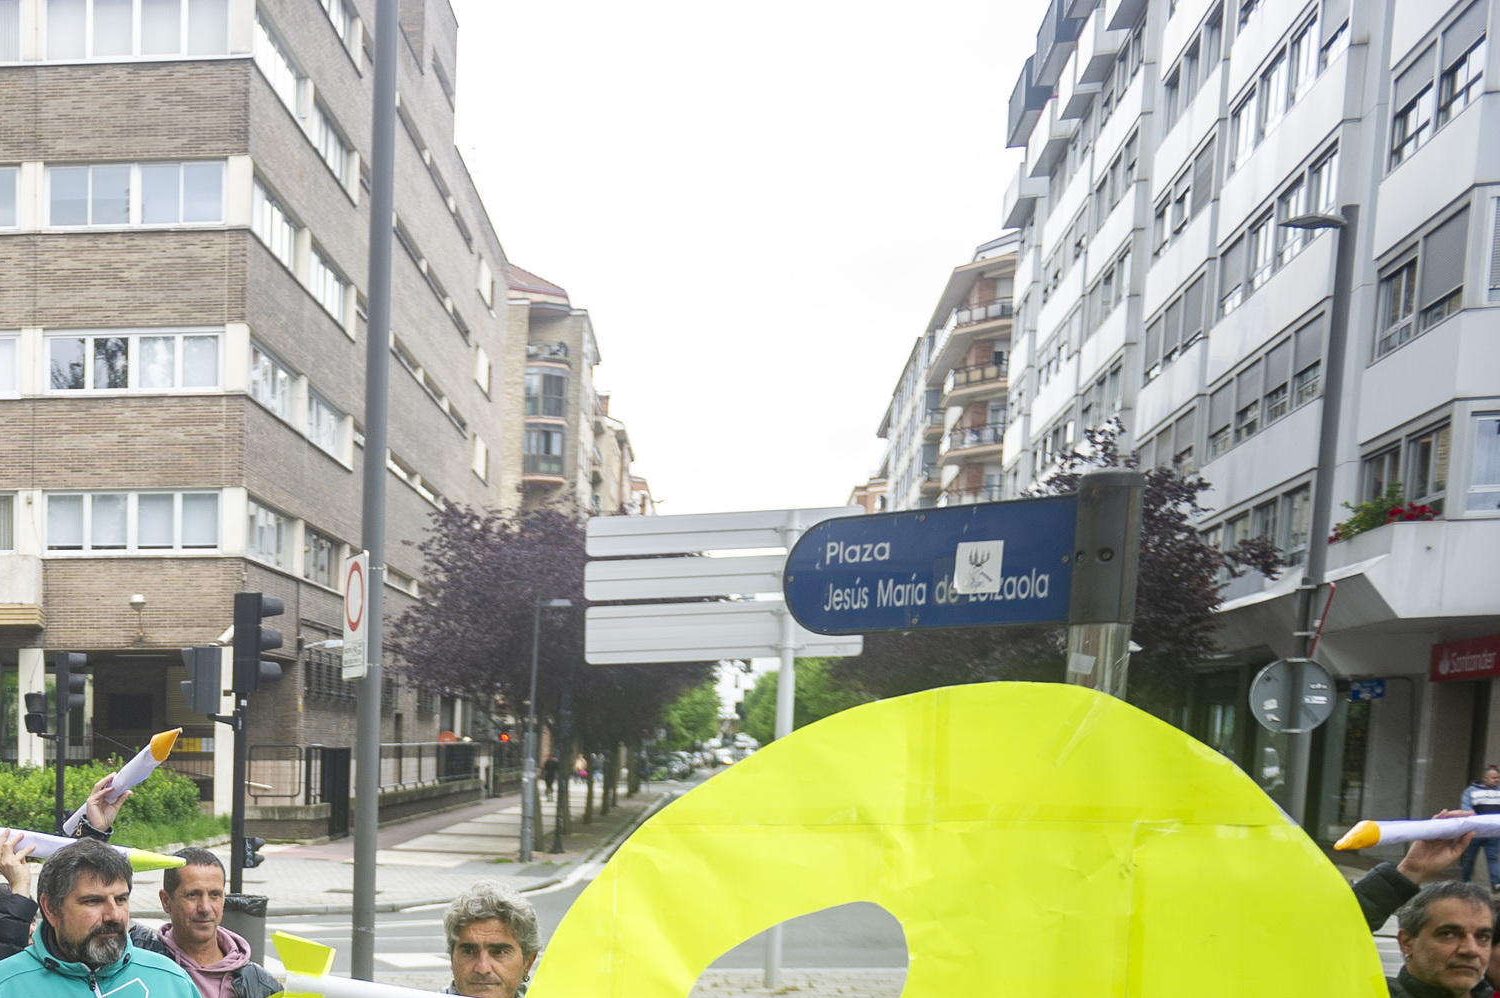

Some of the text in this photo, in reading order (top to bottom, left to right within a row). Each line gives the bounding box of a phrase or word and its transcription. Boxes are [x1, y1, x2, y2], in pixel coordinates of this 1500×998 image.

[825, 541, 890, 565] Plaza
[823, 577, 869, 611] Jesús
[876, 573, 927, 607] María
[935, 574, 959, 605] de
